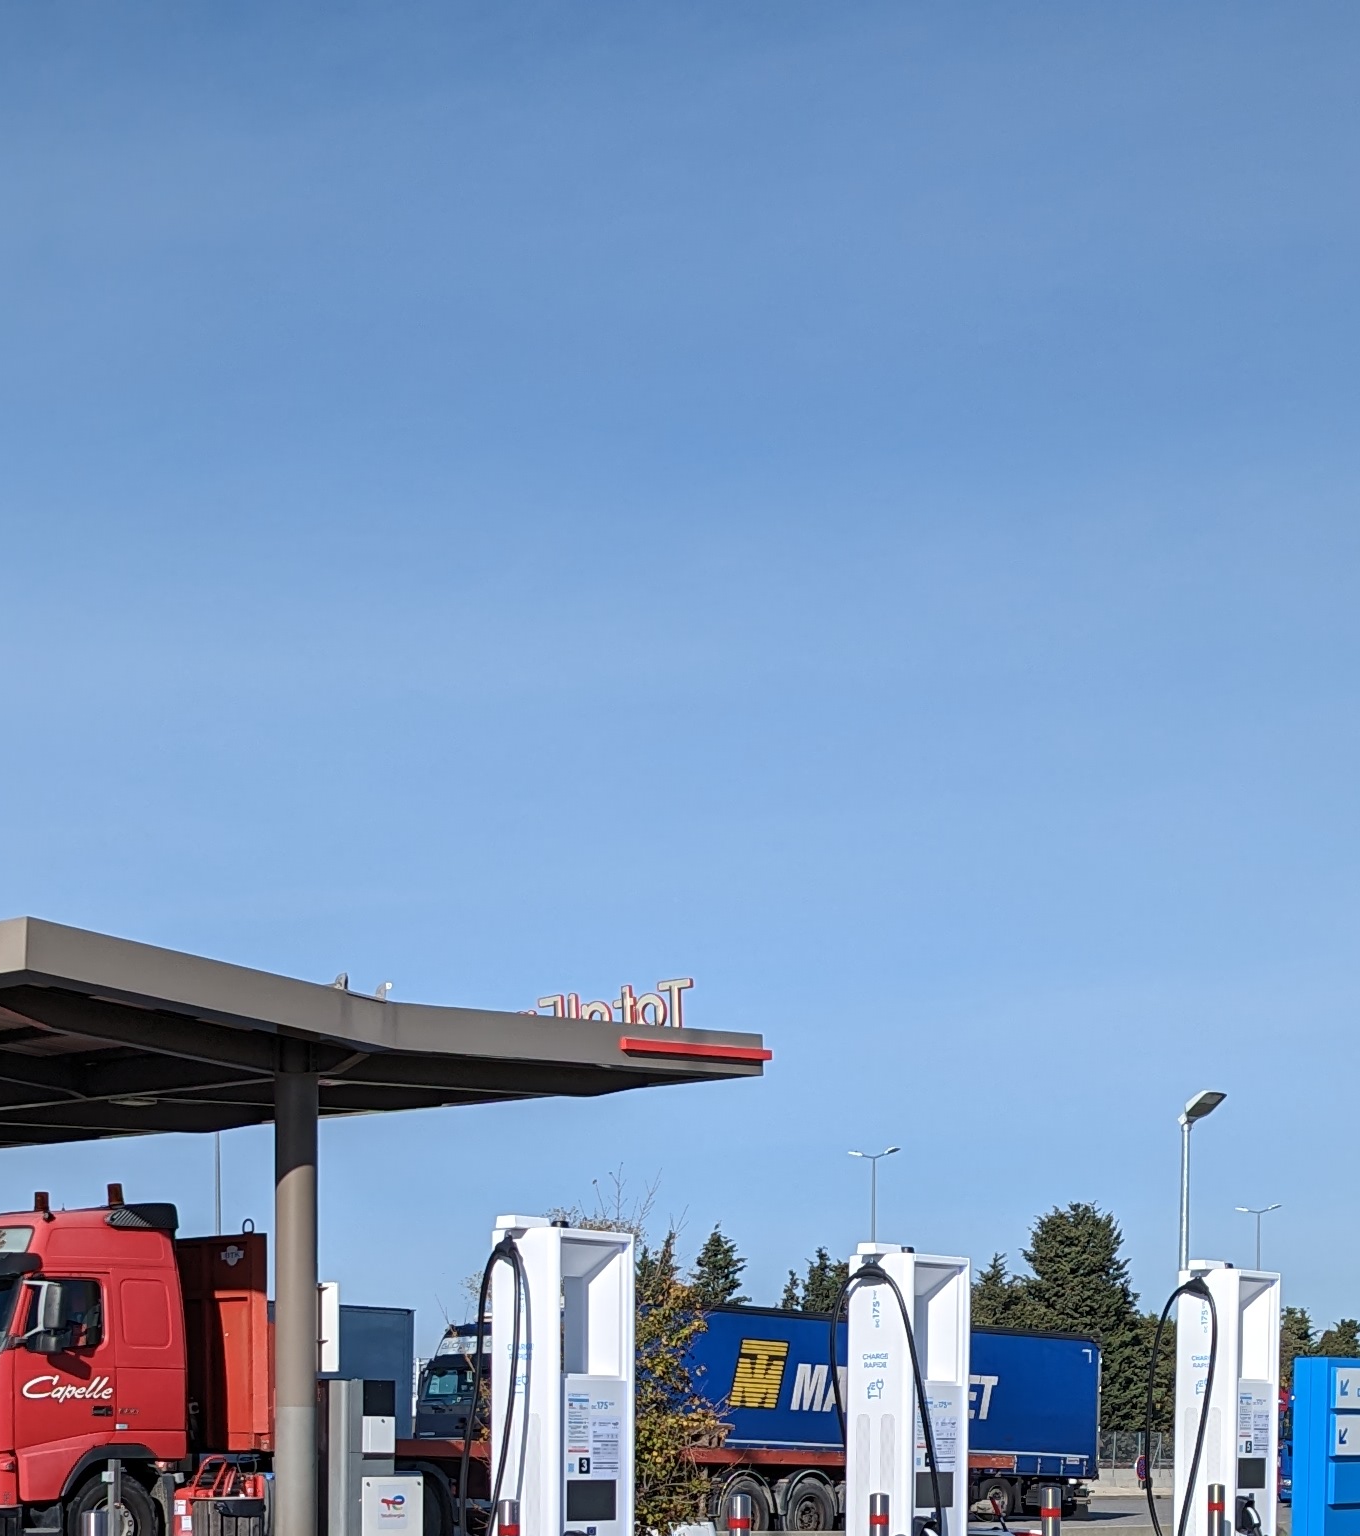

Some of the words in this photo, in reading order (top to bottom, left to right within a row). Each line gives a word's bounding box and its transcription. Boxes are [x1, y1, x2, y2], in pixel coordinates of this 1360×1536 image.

[862, 1353, 889, 1361] CHARGE
[22, 1375, 114, 1403] Capelle
[580, 1458, 588, 1472] 3
